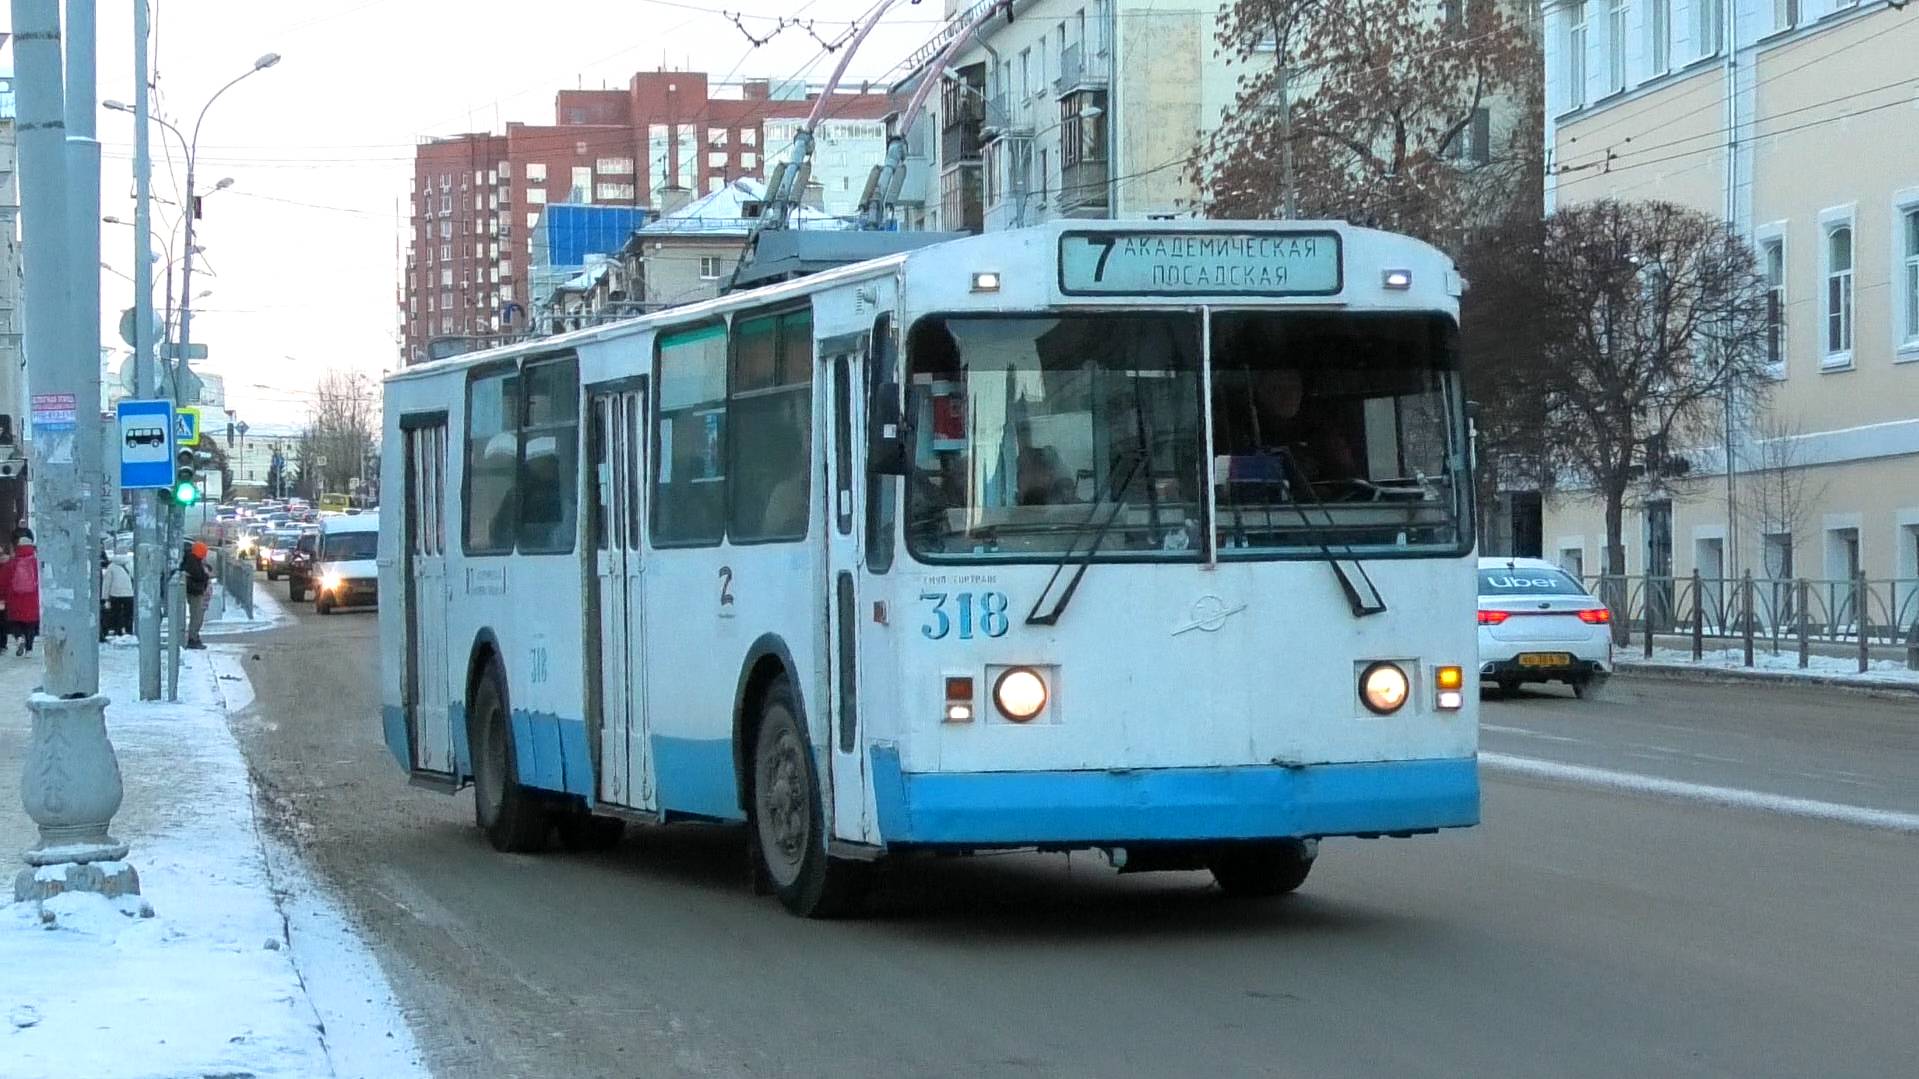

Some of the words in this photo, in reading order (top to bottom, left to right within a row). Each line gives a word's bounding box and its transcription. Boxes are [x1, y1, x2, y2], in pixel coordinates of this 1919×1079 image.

[1087, 236, 1116, 283] 7
[1123, 237, 1317, 259] АКАДЕМИЧЕСКАЯ
[1152, 264, 1288, 287] ПОСАДСКАЯ
[719, 565, 735, 607] 2
[1487, 576, 1559, 588] Uber
[919, 591, 1009, 640] 318
